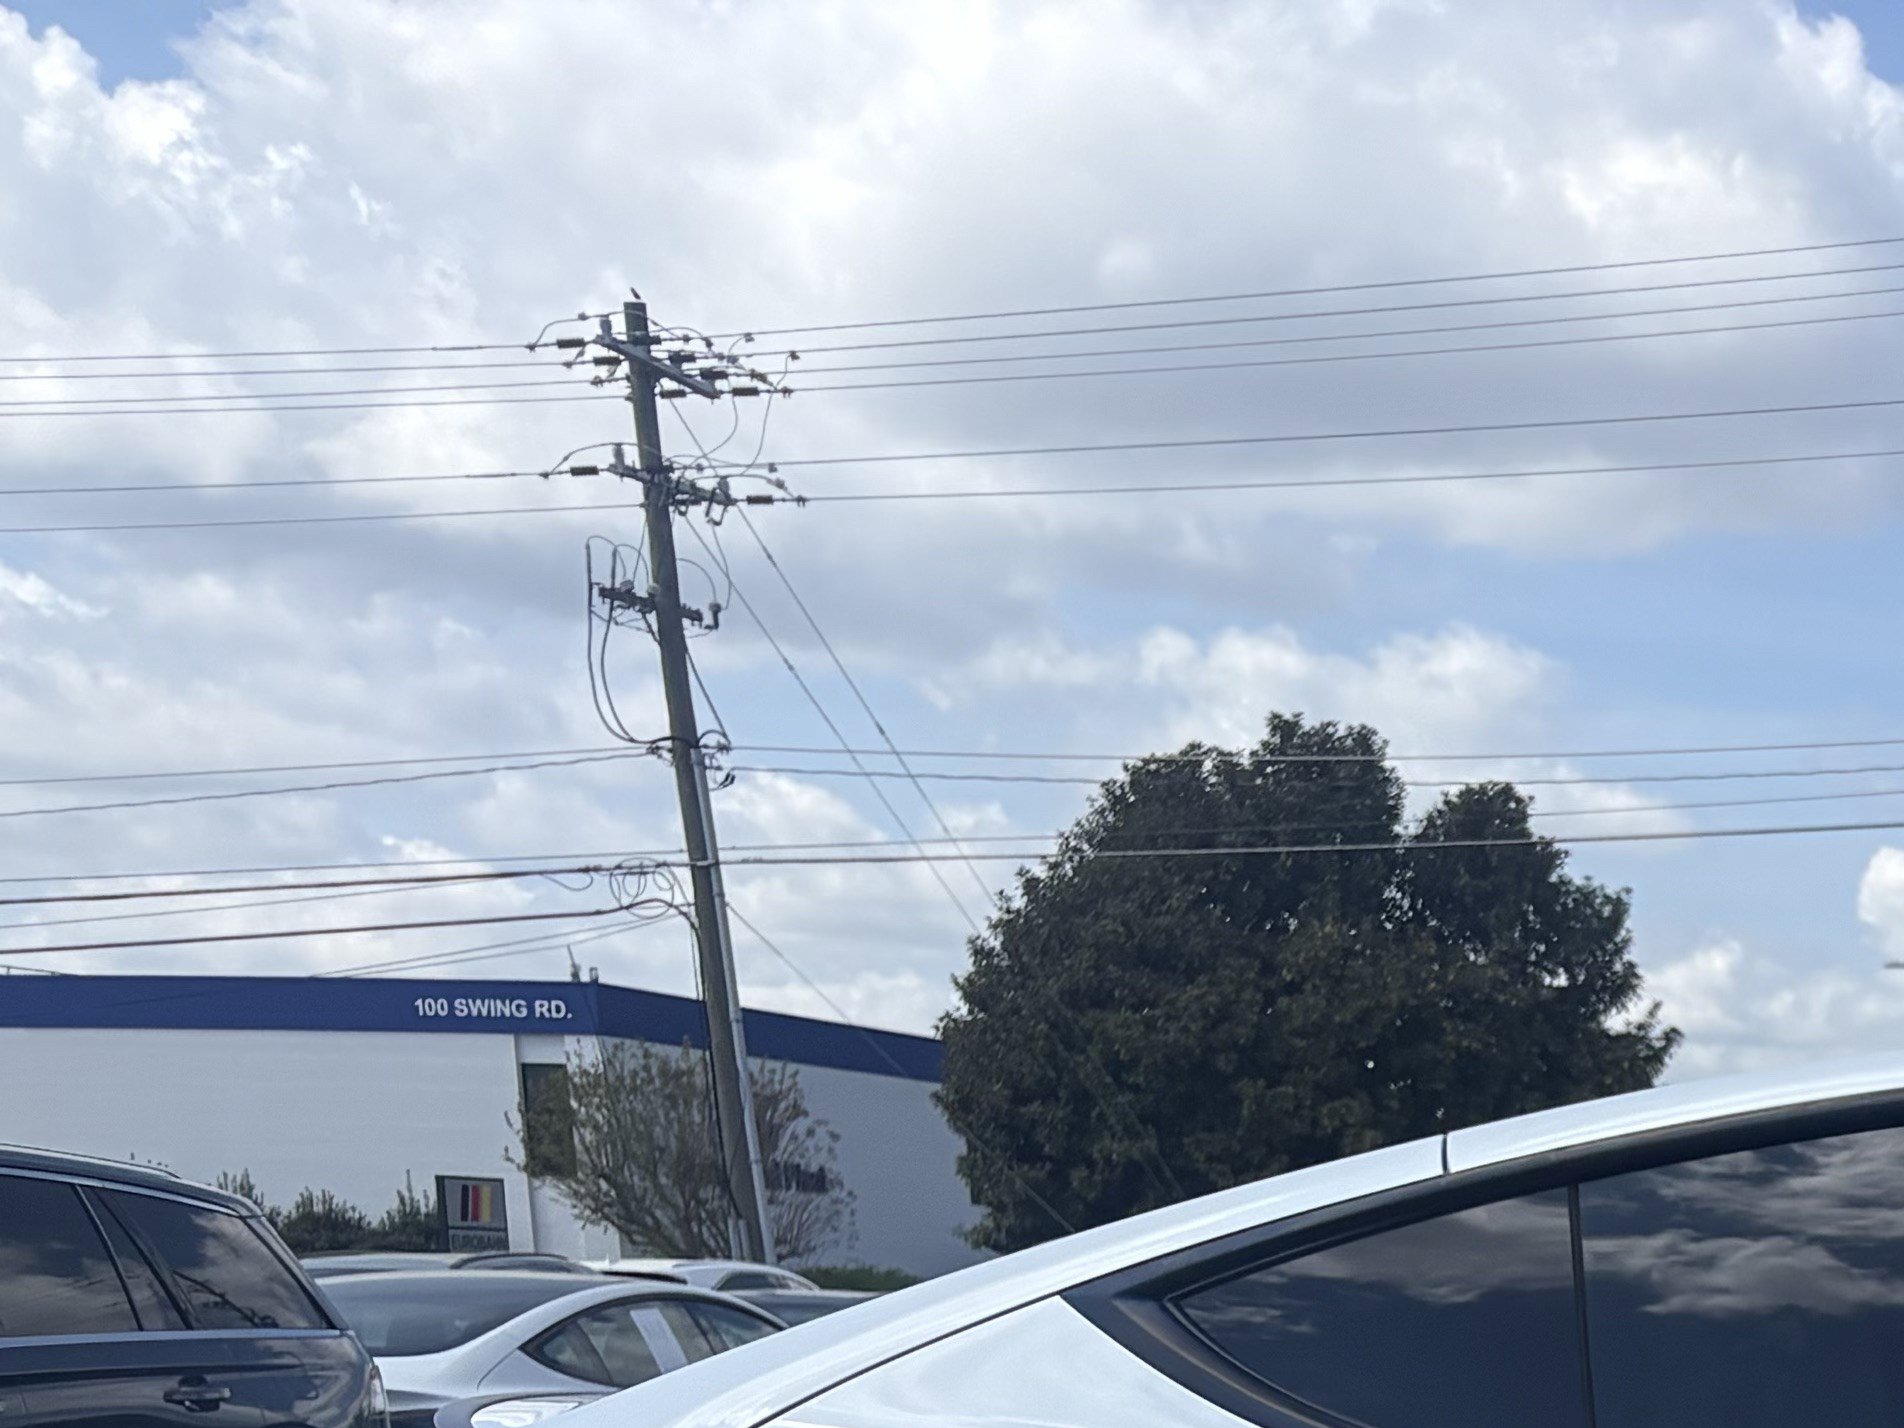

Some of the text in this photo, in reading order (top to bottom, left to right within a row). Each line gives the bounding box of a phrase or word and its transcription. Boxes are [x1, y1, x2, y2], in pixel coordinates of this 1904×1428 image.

[414, 998, 573, 1019] 100 SWING RD.
